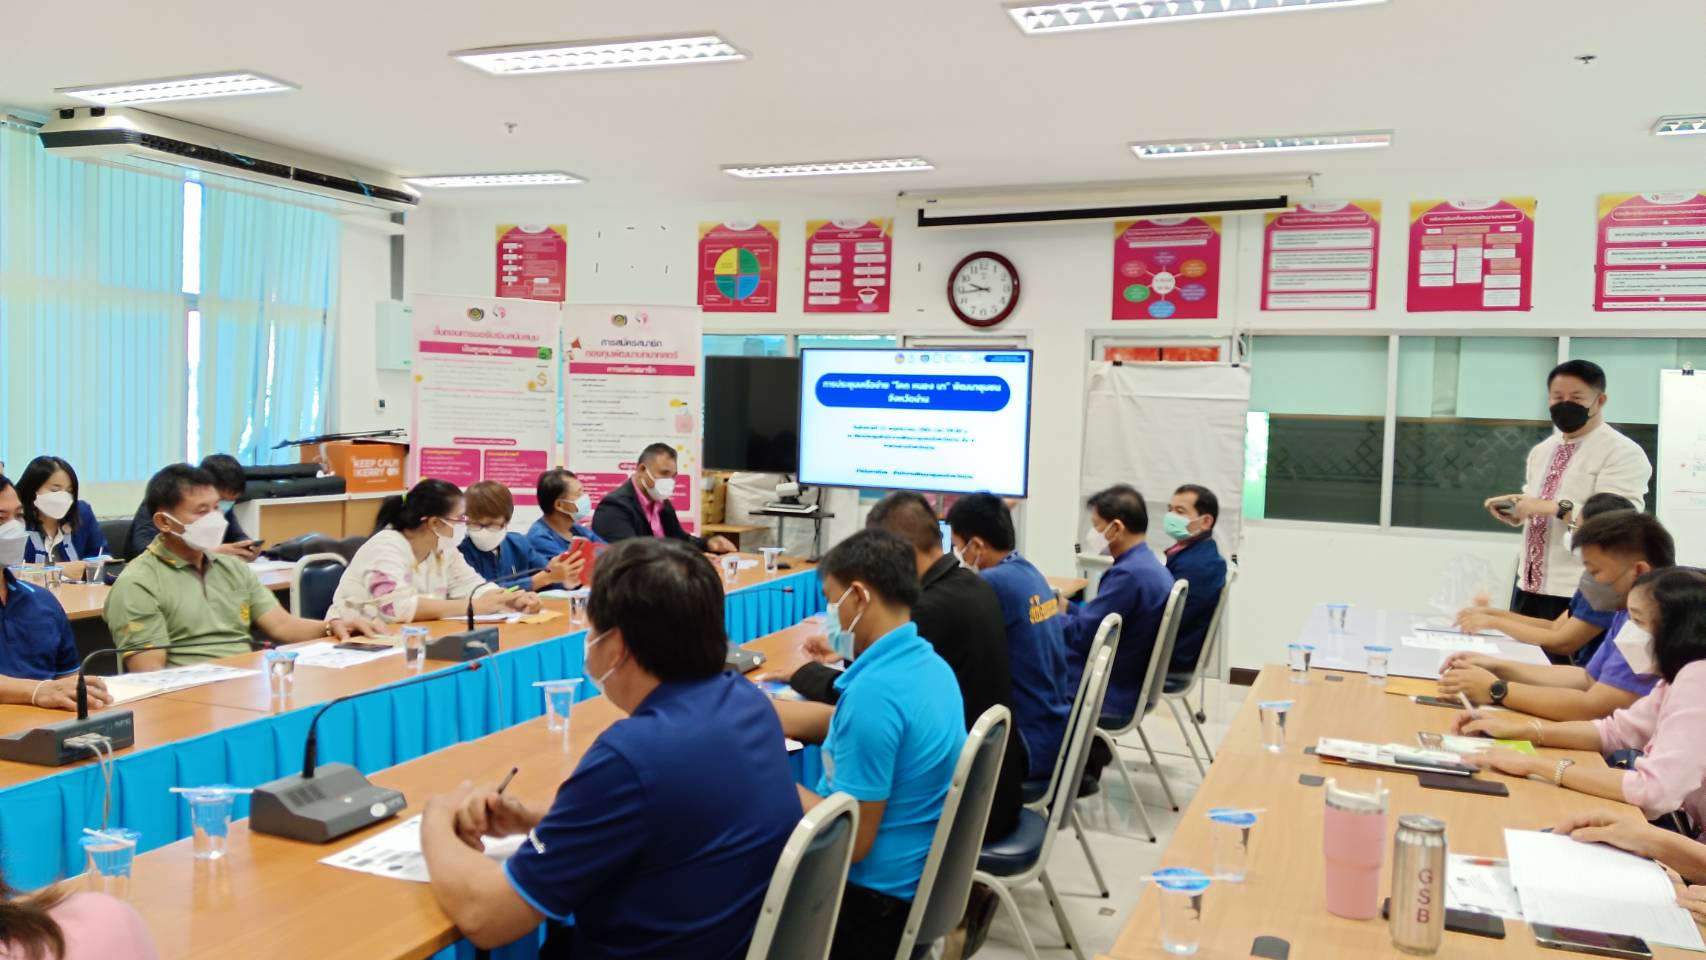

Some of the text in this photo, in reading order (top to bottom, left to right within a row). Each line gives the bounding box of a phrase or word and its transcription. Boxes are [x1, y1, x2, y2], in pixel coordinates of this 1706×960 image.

[601, 337, 663, 347] การสมัครสมาชิก
[353, 457, 400, 468] KEEP CALM
[353, 467, 385, 477] KERRY
[1416, 867, 1433, 924] GSB
